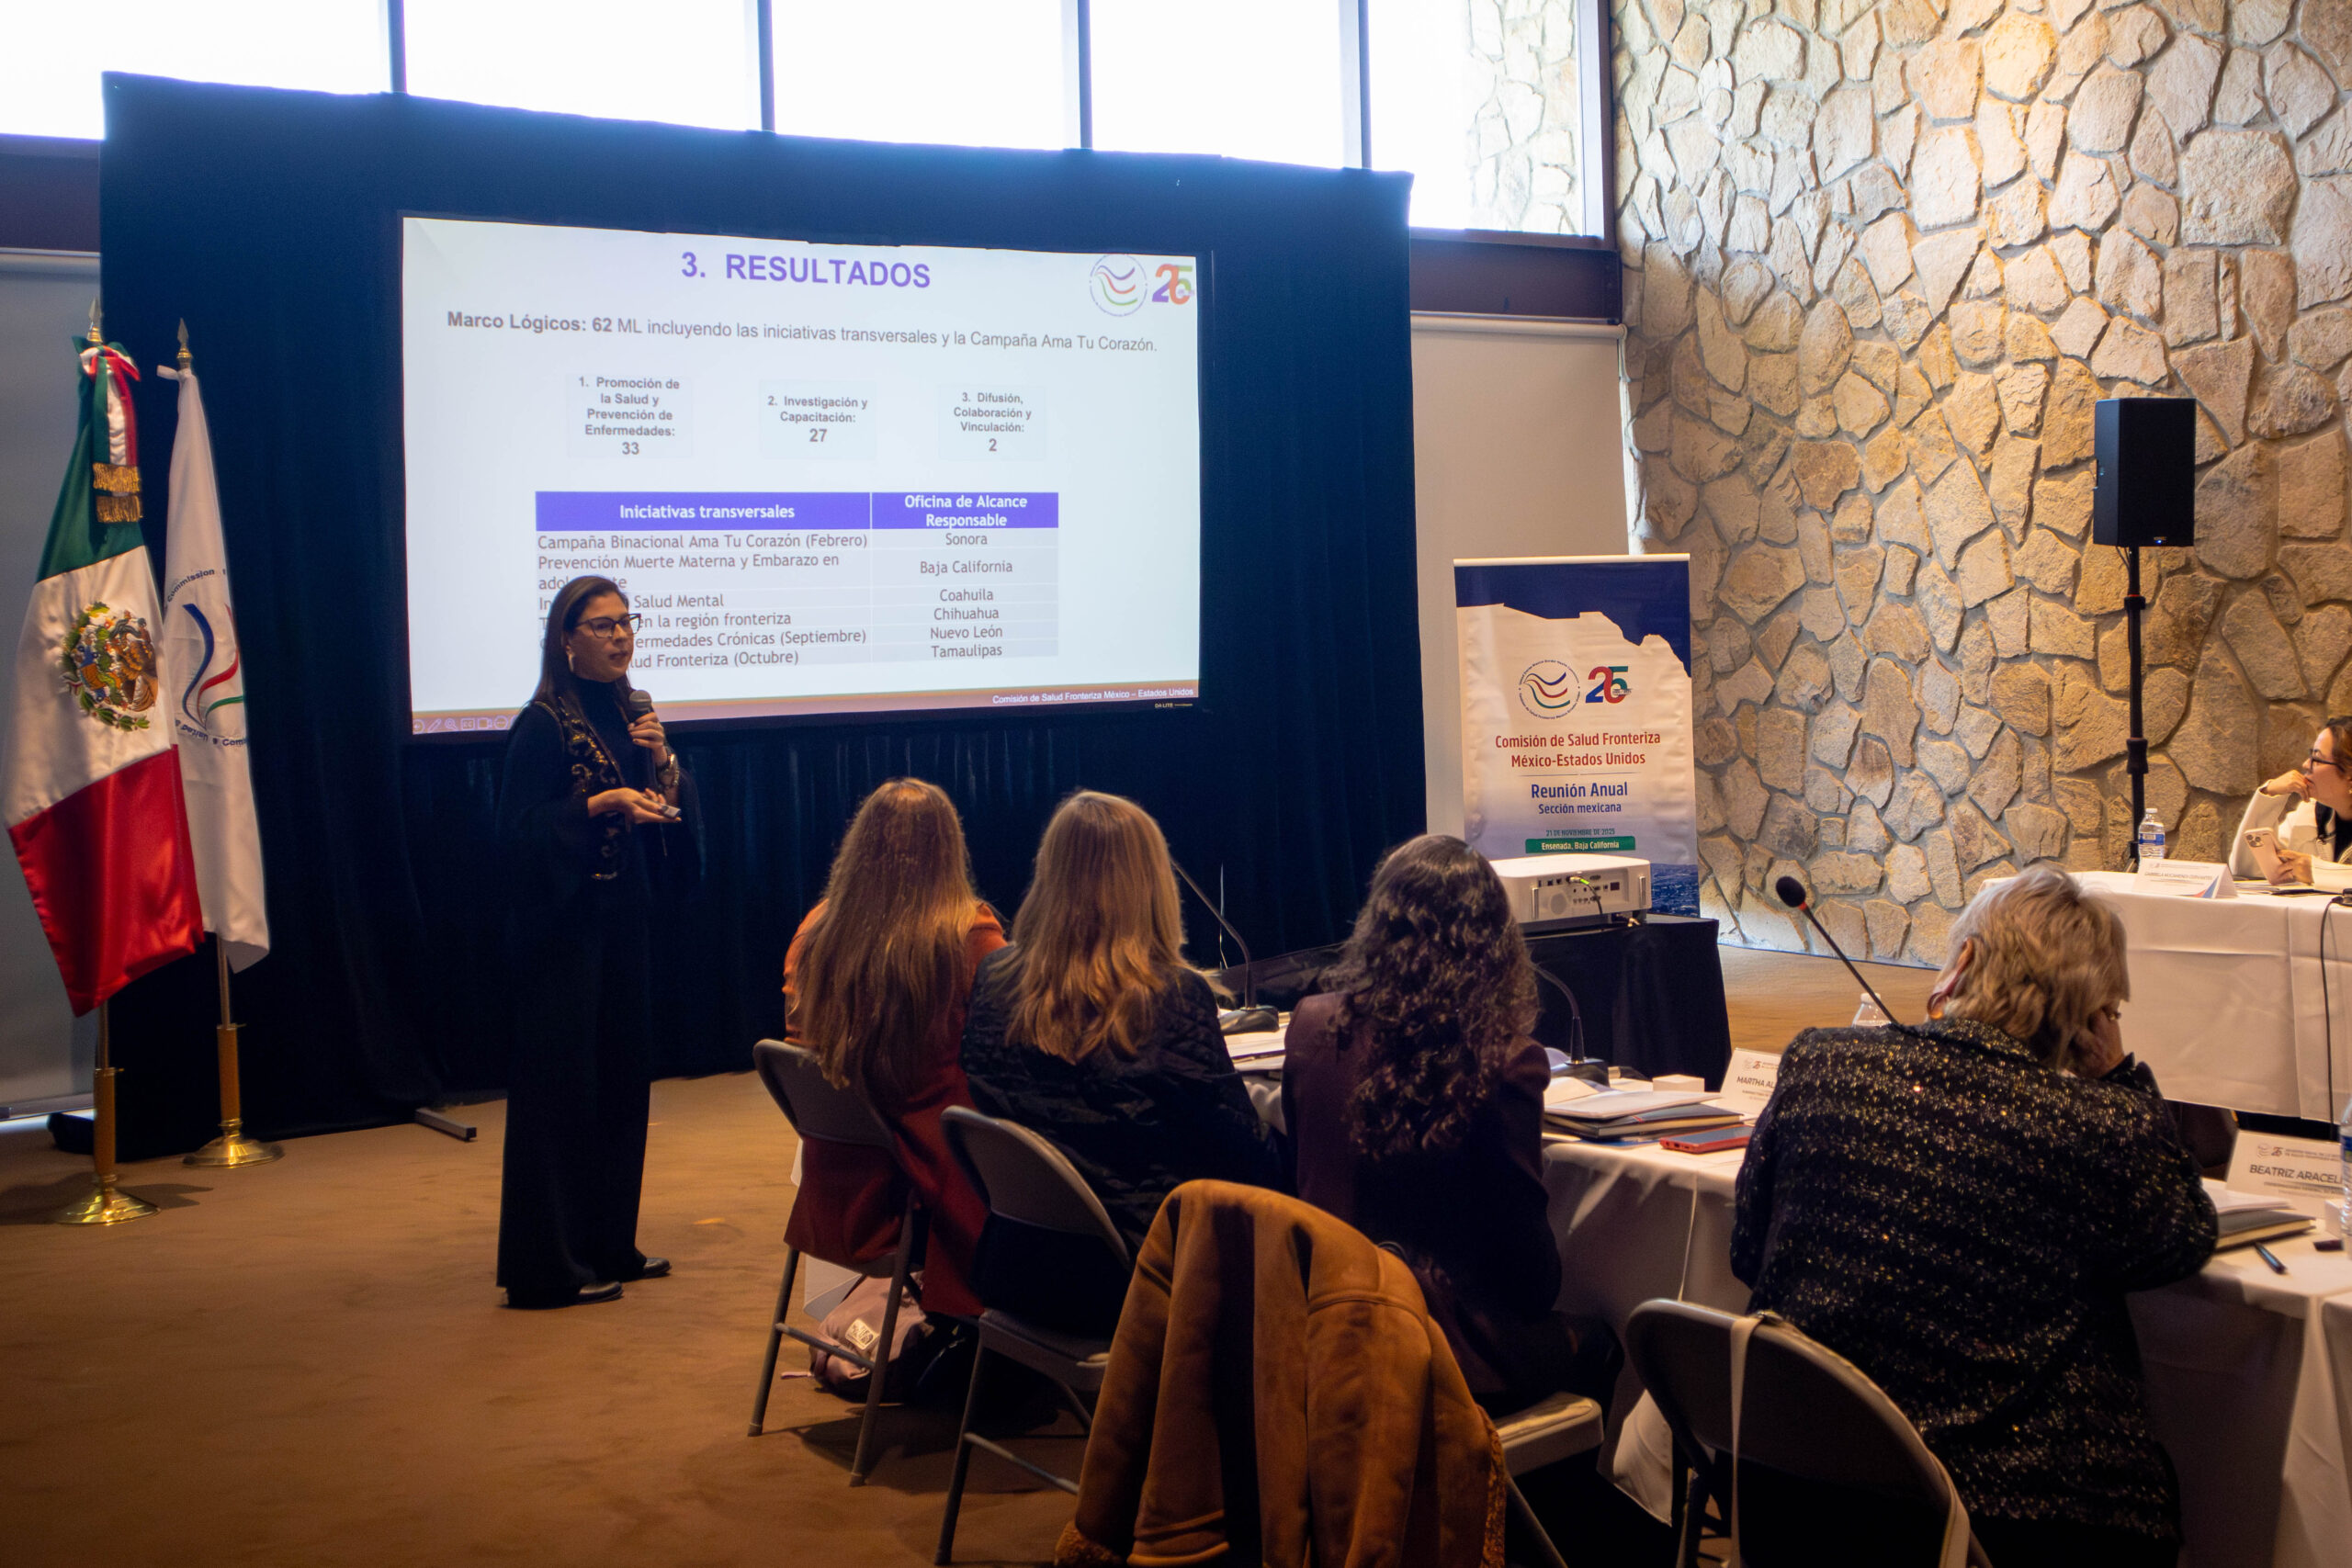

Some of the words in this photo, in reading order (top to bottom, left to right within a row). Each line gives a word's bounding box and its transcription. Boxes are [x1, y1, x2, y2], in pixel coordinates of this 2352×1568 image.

[682, 252, 707, 278] 3.
[726, 254, 931, 288] RESULTADOS
[447, 311, 503, 329] Marco
[509, 314, 587, 335] Lógicos:
[592, 317, 613, 333] 62
[617, 319, 643, 333] ML
[647, 319, 732, 339] incluyendo
[736, 323, 759, 337] las
[763, 324, 836, 341] iniciativas
[841, 327, 937, 344] transversales
[942, 333, 950, 347] y
[954, 331, 967, 344] la
[970, 332, 1037, 349] Campaña
[1042, 334, 1072, 349] Ama
[1078, 335, 1094, 349] Tu
[1098, 335, 1158, 352] Corazón.
[579, 377, 589, 388] 1.
[596, 378, 662, 390] Promoción
[665, 378, 680, 390] de
[600, 393, 612, 404] la
[615, 393, 649, 405] Salud
[652, 397, 660, 407] y
[767, 395, 778, 407] 2.
[784, 395, 858, 410] Investigación
[861, 399, 868, 411] y
[962, 392, 971, 402] 3.
[977, 392, 1023, 405] Difusión,
[587, 408, 656, 421] Prevención
[658, 410, 673, 421] de
[780, 412, 856, 424] Capacitación:
[954, 407, 1023, 419] Colaboración
[1025, 410, 1032, 421] y
[585, 423, 675, 437] Enfermedades:
[960, 421, 1024, 433] Vinculación:
[809, 428, 828, 443] 27
[622, 442, 639, 456] 33
[989, 438, 998, 453] 2
[904, 494, 953, 509] Oficina
[956, 495, 973, 509] de
[977, 494, 1028, 509] Alcance
[619, 504, 695, 520] Iniciativas
[699, 504, 796, 519] transversales
[925, 513, 1008, 530] Responsable
[537, 533, 605, 552] Campaña
[610, 534, 684, 549] Binacional
[689, 535, 720, 548] Ama
[724, 534, 741, 548] Tu
[746, 533, 800, 548] Corazón
[805, 533, 868, 549] (Febrero)
[944, 532, 988, 547] Sonora
[538, 554, 619, 570] Prevención
[624, 555, 675, 569] Muerte
[679, 555, 736, 569] Materna
[741, 558, 749, 571] y
[752, 553, 819, 567] Embarazo
[822, 555, 840, 567] en
[920, 560, 948, 577] Baja
[952, 559, 1013, 574] California
[167, 569, 215, 603] Commission
[634, 594, 673, 609] Salud
[676, 593, 725, 608] Mental
[939, 588, 994, 603] Coahuila
[658, 614, 671, 628] la
[675, 613, 719, 631] región
[724, 611, 792, 626] fronteriza
[933, 606, 1000, 621] Chihuahua
[635, 632, 714, 649] ermedades
[717, 630, 775, 647] Crónicas
[780, 629, 866, 648] (Septiembre)
[930, 626, 969, 640] Nuevo
[973, 624, 1003, 639] León
[630, 654, 652, 669] lud
[656, 652, 729, 668] Fronteriza
[733, 650, 799, 668] (Octubre)
[931, 644, 1003, 660] Tamaulipas
[992, 694, 1028, 705] Comisión
[1030, 694, 1039, 704] de
[1041, 693, 1063, 703] Salud
[1065, 691, 1102, 702] Fronteriza
[1103, 688, 1130, 700] México
[1137, 689, 1167, 699] Estados
[1169, 687, 1194, 697] Unidos
[1495, 734, 1547, 749] Comisión
[1550, 734, 1565, 748] de
[1567, 733, 1600, 747] Salud
[1602, 731, 1661, 746] Fronteriza
[1511, 753, 1602, 768] México-Estados
[1606, 751, 1645, 765] Unidos
[1531, 783, 1586, 799] Reunión
[1590, 782, 1628, 797] Anual
[1538, 802, 1575, 815] Sección
[1577, 802, 1622, 814] mexicana
[1562, 829, 1591, 837] NOVIEMBRE
[1574, 841, 1589, 851] Baja
[1590, 840, 1620, 850] California
[1736, 1076, 1765, 1087] MARTHA
[2249, 1164, 2295, 1179] BEATRIZ
